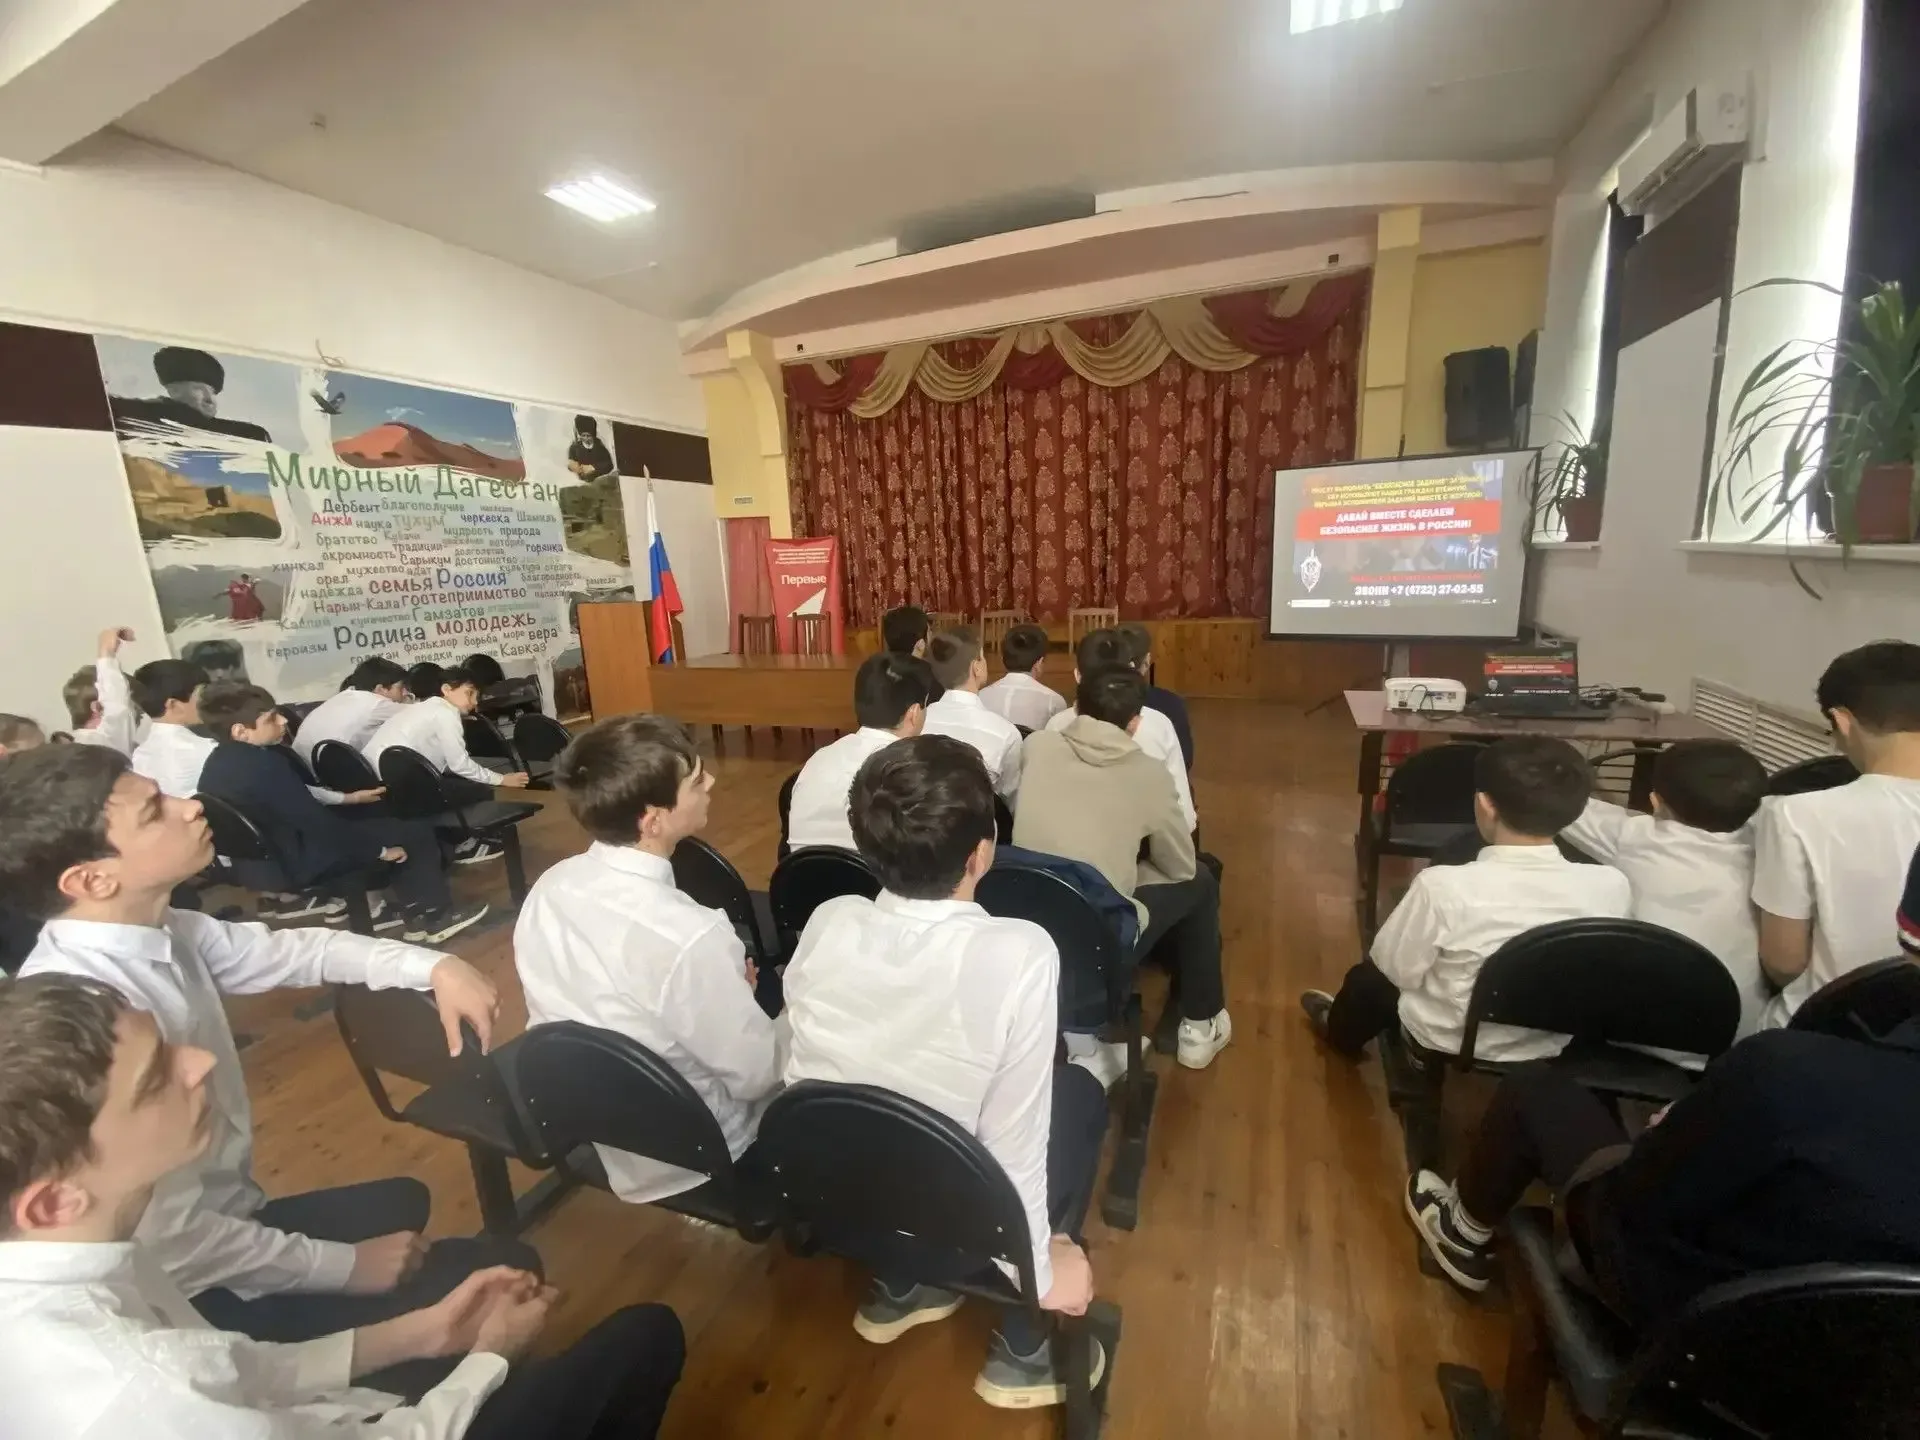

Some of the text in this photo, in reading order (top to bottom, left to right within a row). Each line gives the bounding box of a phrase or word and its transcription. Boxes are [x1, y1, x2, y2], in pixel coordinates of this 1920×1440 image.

[265, 451, 559, 503] Мирный Дагестан
[322, 498, 381, 516] Дербент
[380, 497, 465, 516] благополучие
[311, 512, 353, 526] Анжи
[461, 511, 511, 526] черкеска
[1336, 507, 1455, 523] ДАВАЙ ВМЕСТЕ СДЕЛАЕМ
[355, 519, 393, 532] наука
[444, 526, 494, 539] мудрость
[500, 526, 541, 539] природа
[1380, 521, 1416, 533] ЖИЗНЬ
[1418, 521, 1426, 531] В
[1427, 519, 1472, 530] РОССИИ!
[316, 532, 378, 549] братство
[322, 550, 397, 564] скромность
[526, 543, 564, 556] горянка
[272, 561, 324, 573] хинкал
[400, 553, 452, 567] Сарыкум
[454, 556, 519, 567] достоинство
[346, 565, 405, 578] мужество
[436, 567, 507, 588] Россия
[316, 573, 350, 588] орел
[369, 577, 433, 594] семья
[781, 574, 827, 588] Первые
[300, 585, 364, 600] надежда
[401, 587, 526, 608] гостеприимство
[313, 598, 400, 616] Нарын-Кала
[411, 605, 485, 622] Гамзатов
[436, 612, 536, 636] молодежь
[333, 624, 426, 650] Родина
[464, 634, 498, 648] борьба
[503, 630, 525, 641] море
[528, 627, 558, 644] вера
[266, 643, 328, 662] героизм
[403, 636, 458, 655] фольклор
[500, 642, 547, 657] Кавказ
[414, 650, 452, 663] предки
